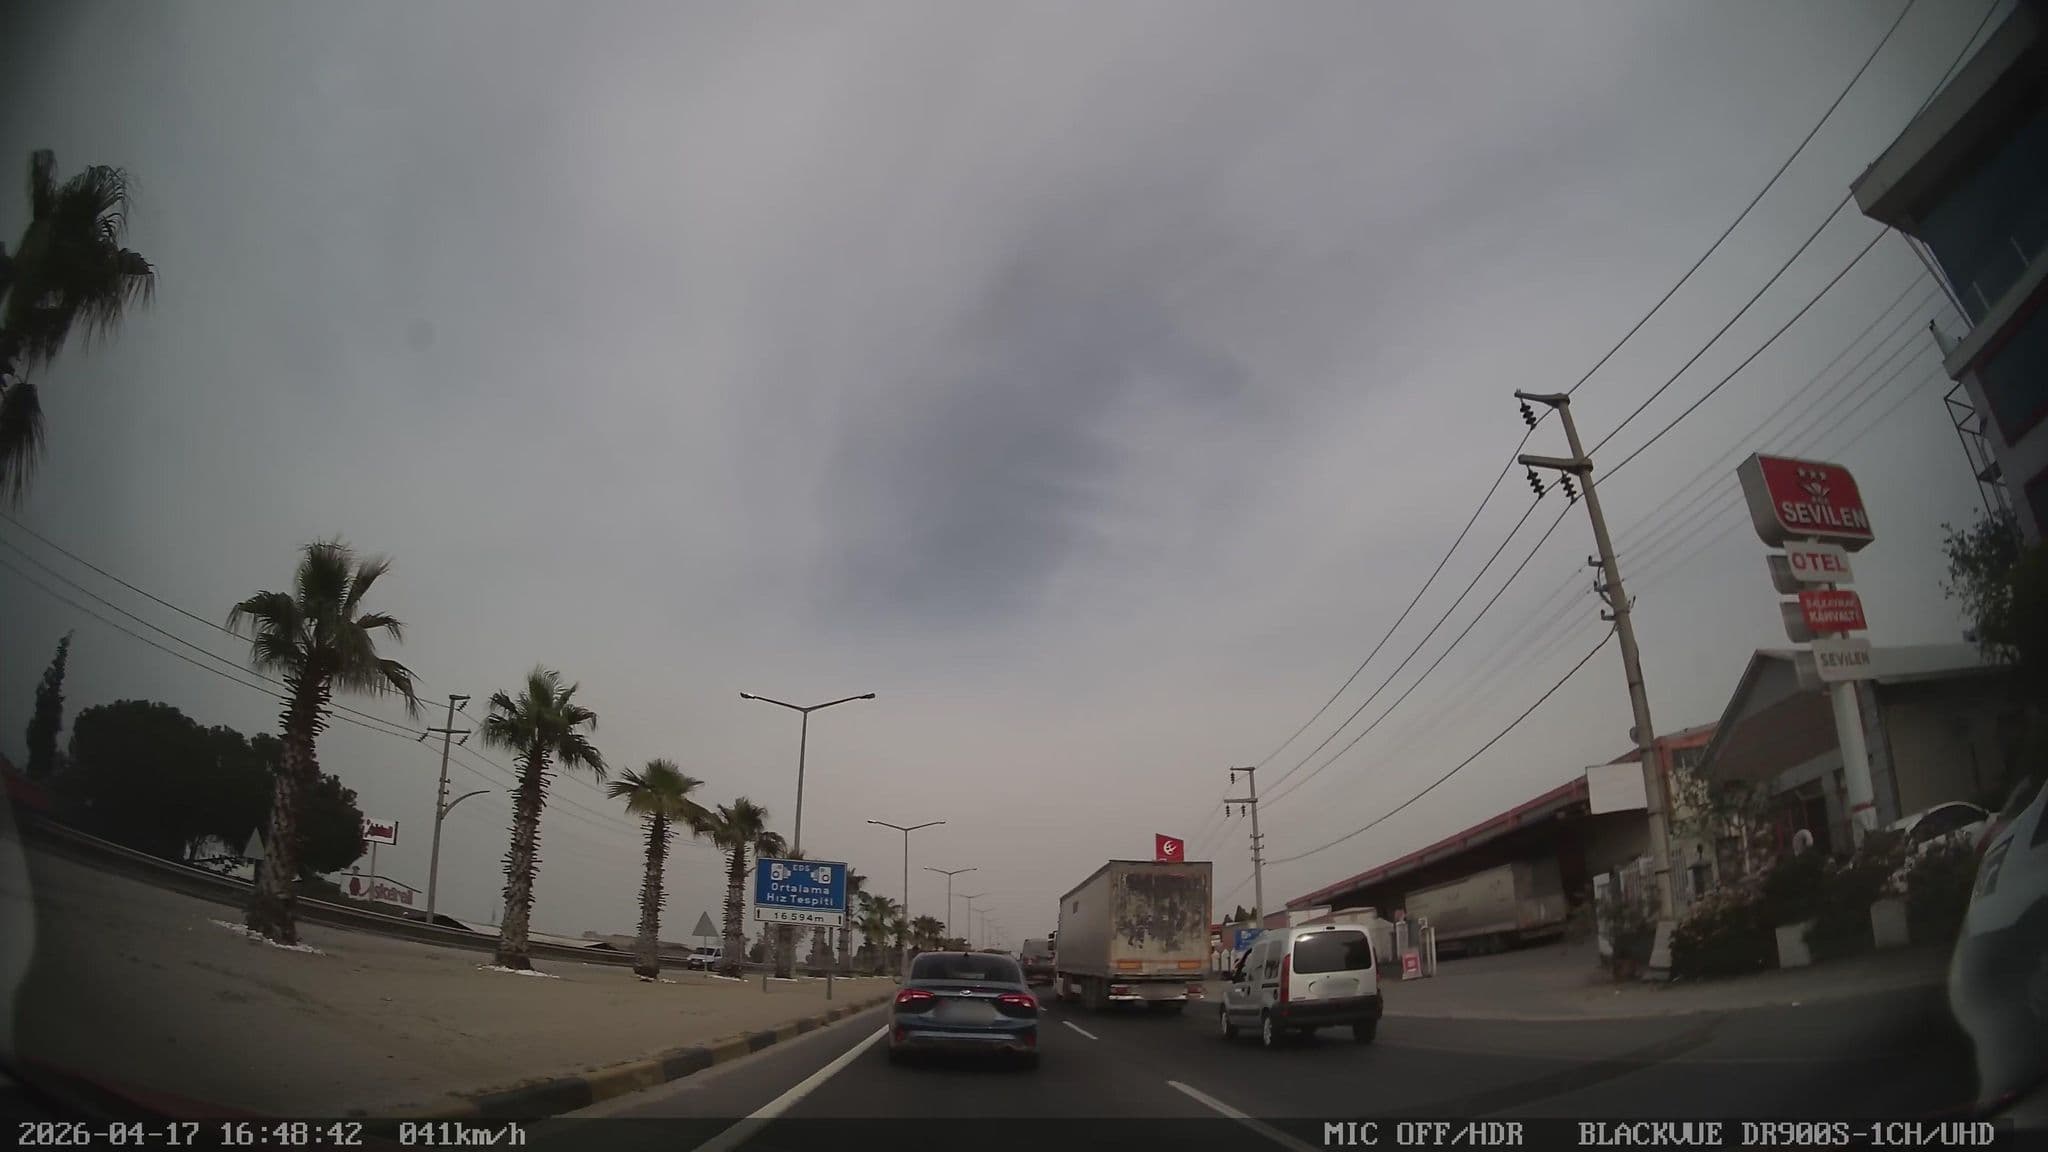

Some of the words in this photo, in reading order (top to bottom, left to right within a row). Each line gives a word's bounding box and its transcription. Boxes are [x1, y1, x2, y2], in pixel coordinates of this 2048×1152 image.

[1791, 551, 1849, 572] OTEL
[771, 882, 830, 895] Ortalama
[766, 892, 788, 903] Hız
[790, 894, 833, 906] Tespiti
